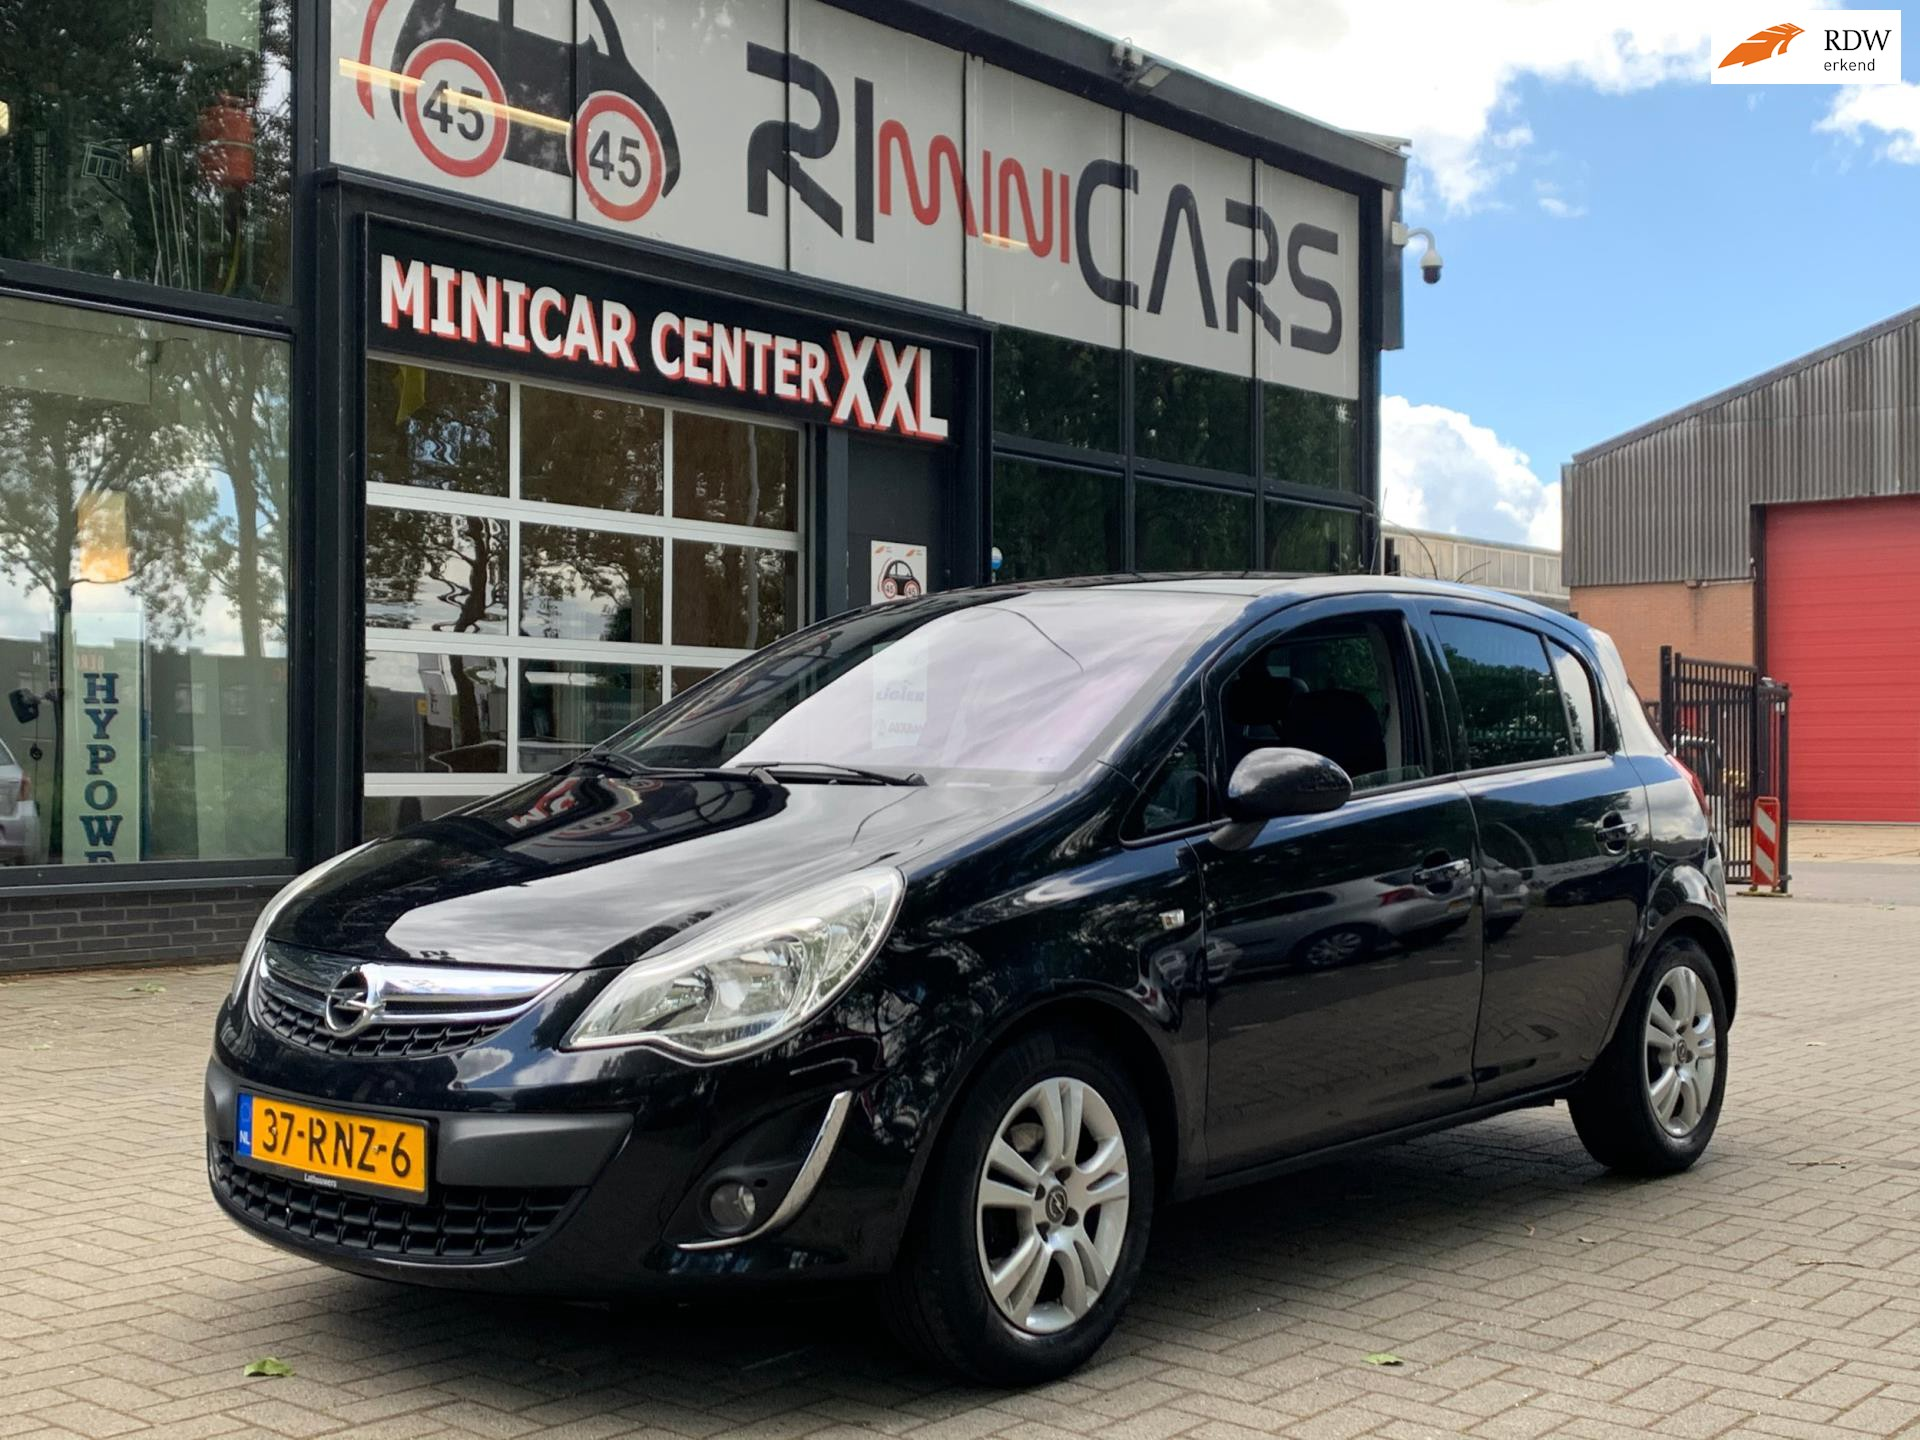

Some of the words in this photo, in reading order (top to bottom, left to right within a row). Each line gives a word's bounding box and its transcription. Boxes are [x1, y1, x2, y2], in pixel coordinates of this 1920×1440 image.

[423, 79, 485, 141] 45
[588, 130, 642, 188] 45
[381, 254, 639, 371] MINICAR
[651, 311, 831, 406] CENTER
[832, 329, 948, 441] XXL
[239, 1130, 251, 1146] NL
[262, 1108, 412, 1178] 37-RNZ-6
